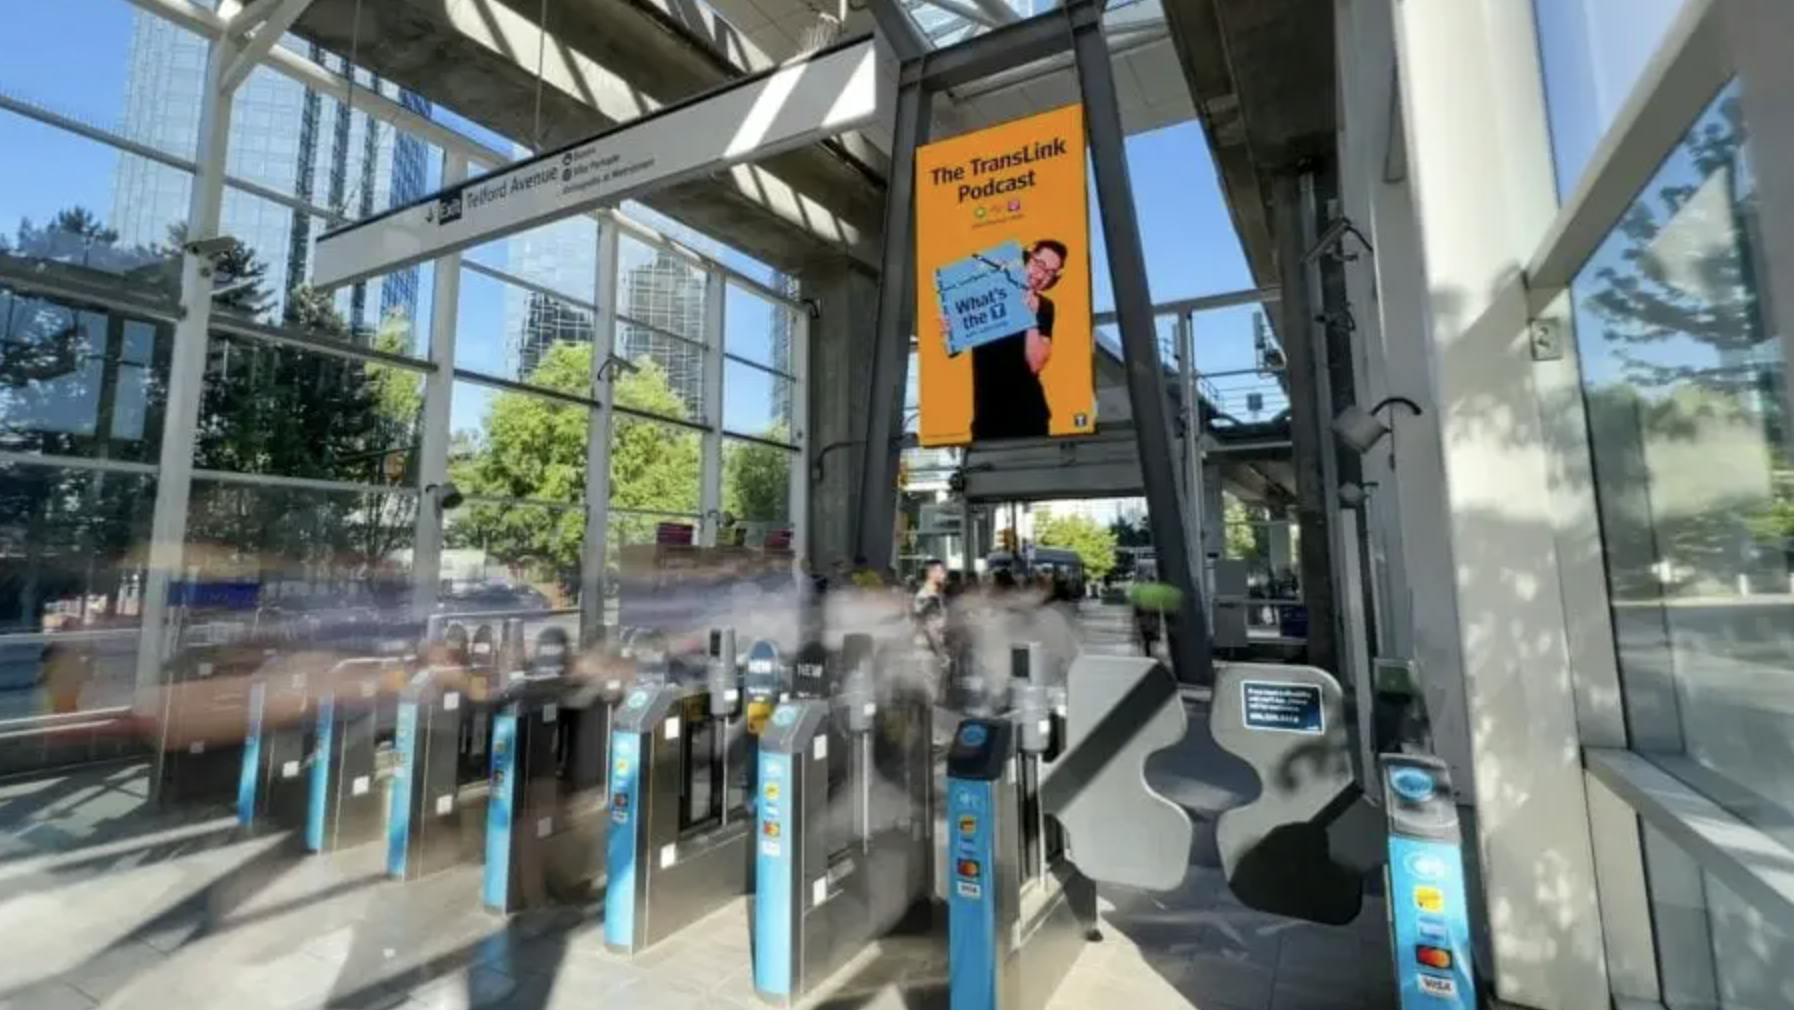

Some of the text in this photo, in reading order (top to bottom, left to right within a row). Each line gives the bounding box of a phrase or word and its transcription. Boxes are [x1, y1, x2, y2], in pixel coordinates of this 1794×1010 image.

[931, 137, 1067, 186] The TransLink
[467, 180, 506, 208] Telford
[510, 166, 558, 193] Avenue
[958, 170, 1037, 203] Podcast
[955, 287, 1008, 315] What's
[963, 312, 988, 331] the
